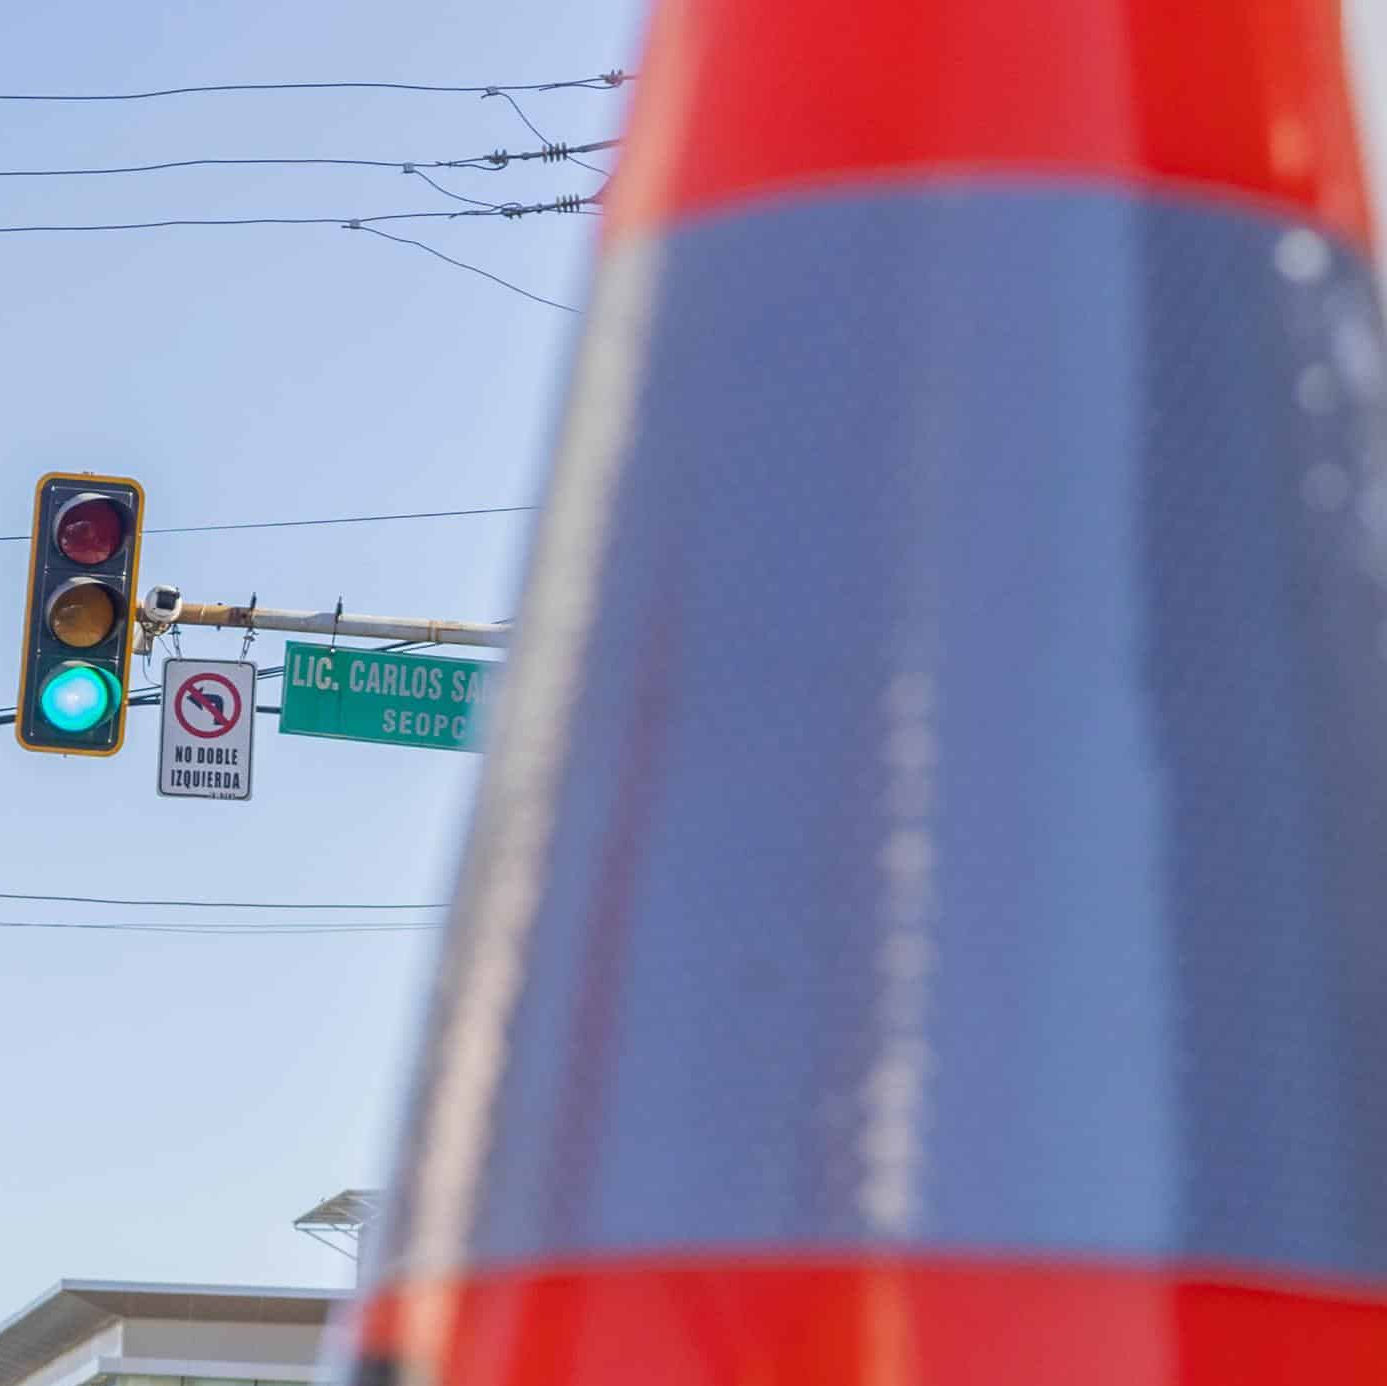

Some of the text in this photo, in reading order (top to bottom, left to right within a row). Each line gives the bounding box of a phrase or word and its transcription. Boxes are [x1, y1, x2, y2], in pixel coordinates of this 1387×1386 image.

[292, 653, 340, 692] LIC.
[349, 659, 444, 700] CARLOS
[175, 745, 239, 766] NO DOBLE
[170, 768, 241, 789] IZQUIERDA
